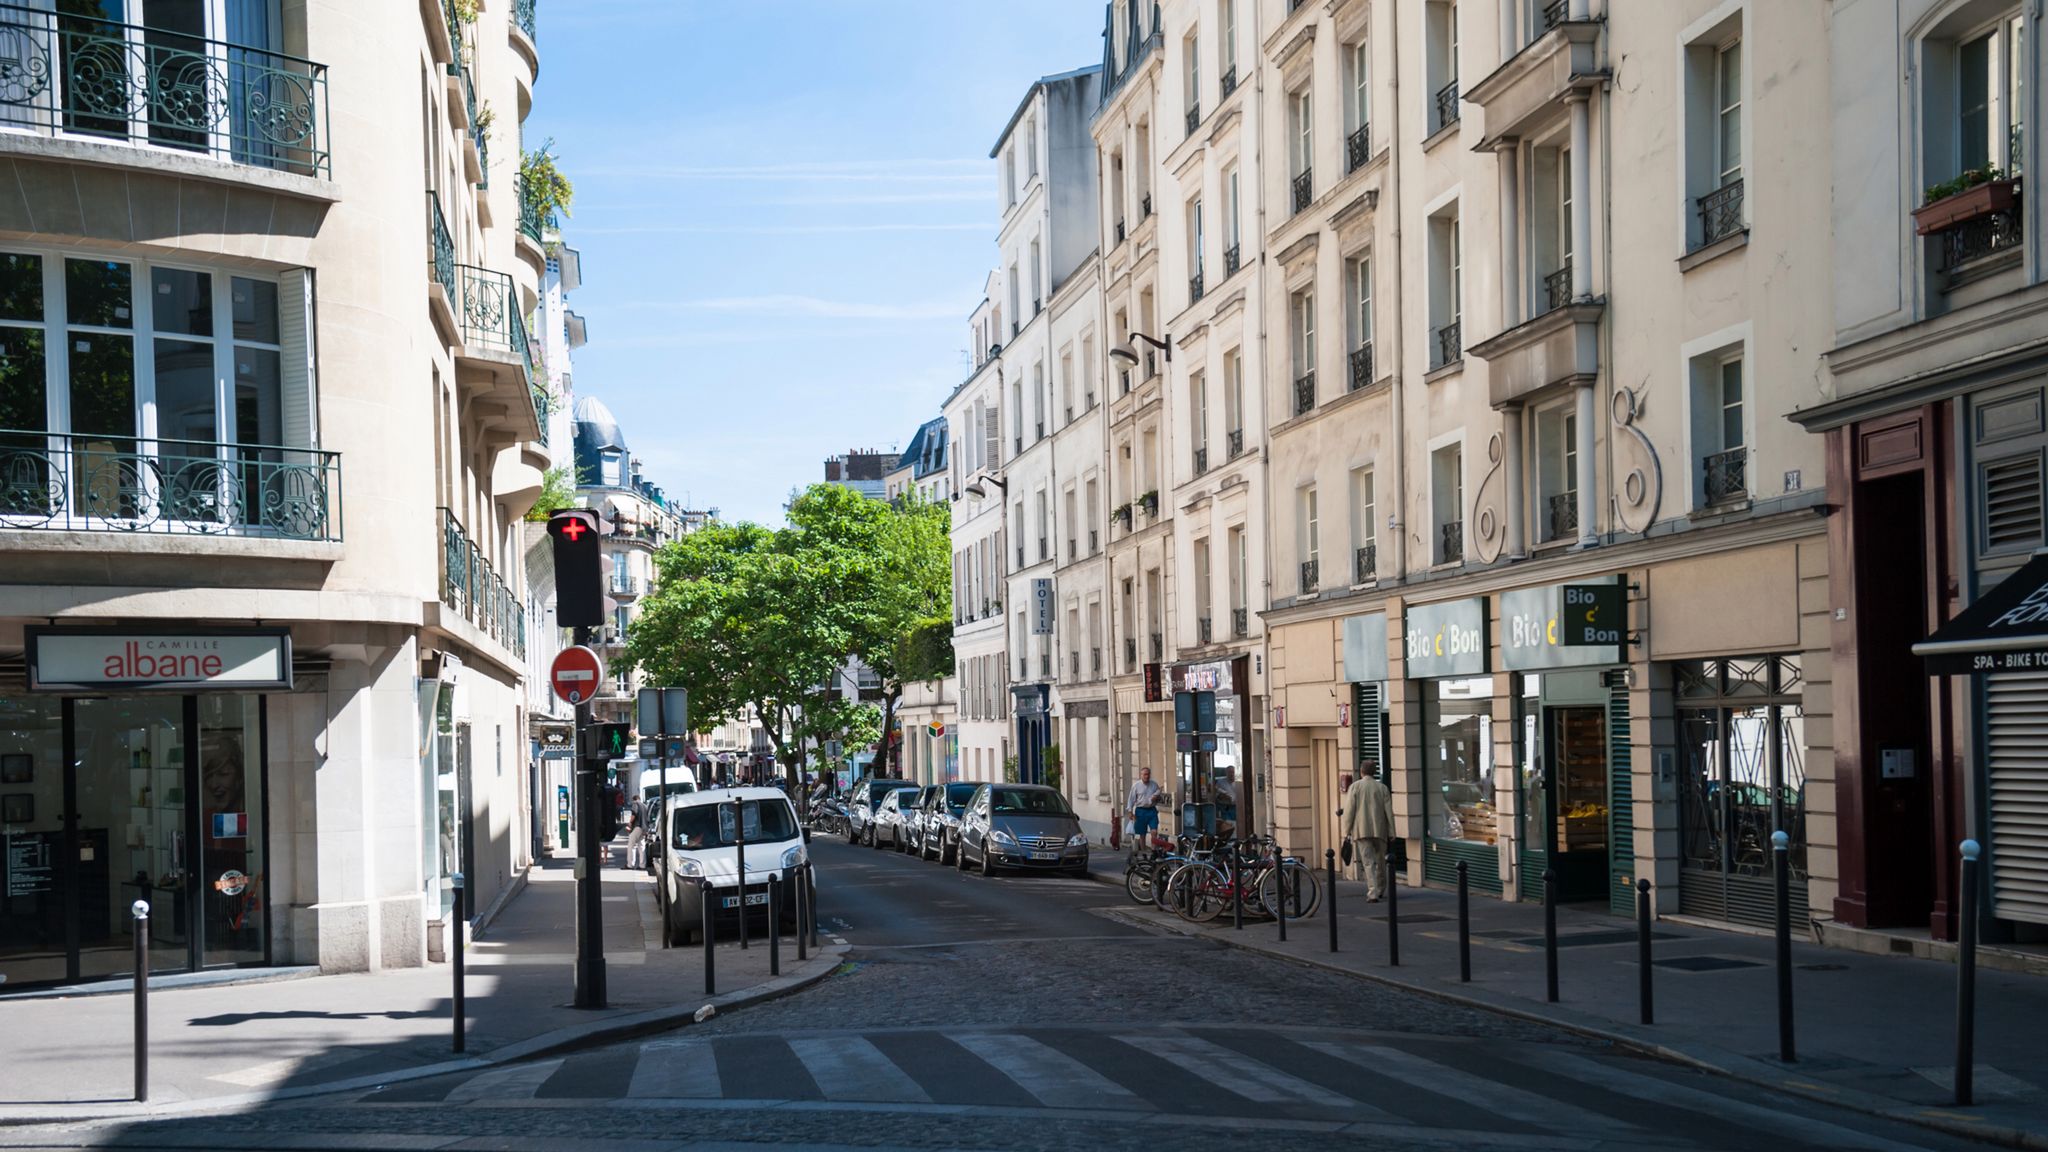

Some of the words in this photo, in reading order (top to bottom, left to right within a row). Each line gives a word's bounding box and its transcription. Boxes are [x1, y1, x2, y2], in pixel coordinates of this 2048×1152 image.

[1038, 579, 1047, 628] HOTEL
[1565, 588, 1595, 604] Bio
[1407, 629, 1430, 659] Bio
[1450, 624, 1479, 655] Bon
[1512, 614, 1540, 648] Bio
[1584, 627, 1619, 642] Bon
[146, 640, 219, 649] CAMILLE
[104, 640, 222, 678] albane
[1973, 655, 1994, 669] SPA
[2006, 653, 2031, 667] BIKE
